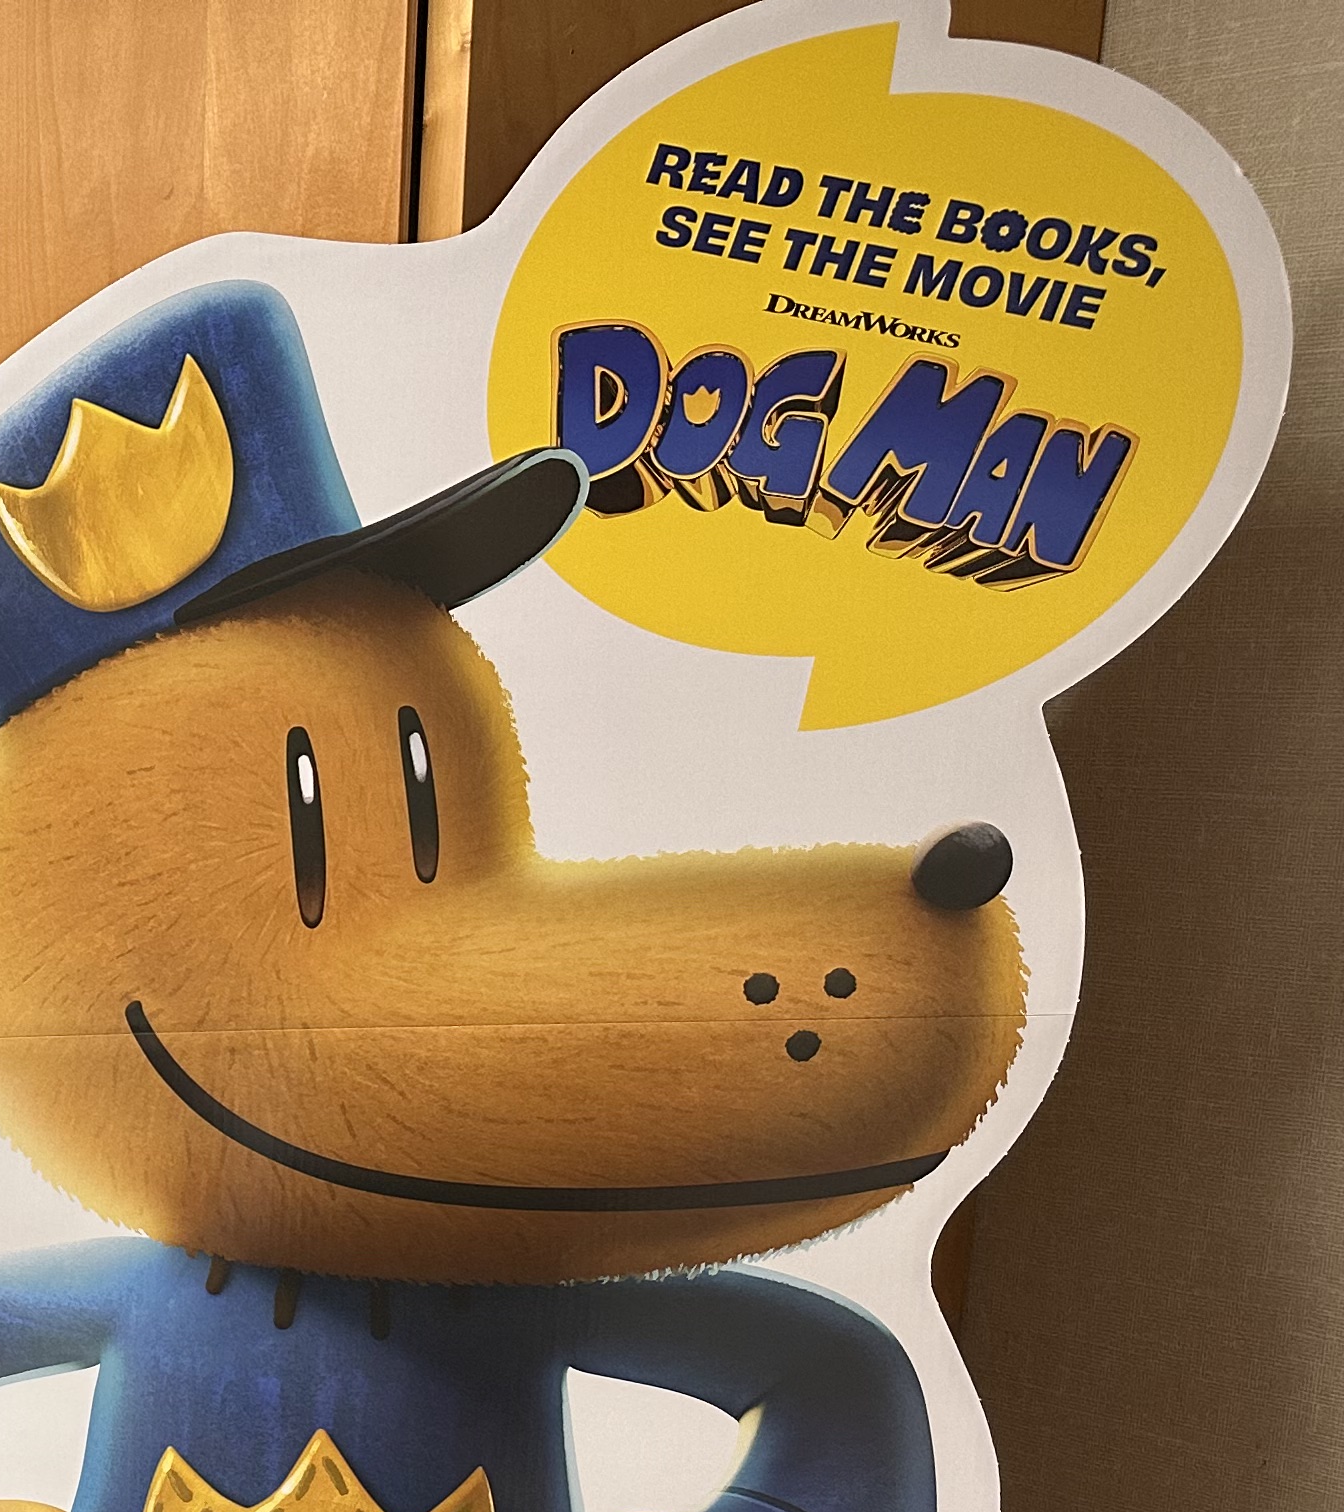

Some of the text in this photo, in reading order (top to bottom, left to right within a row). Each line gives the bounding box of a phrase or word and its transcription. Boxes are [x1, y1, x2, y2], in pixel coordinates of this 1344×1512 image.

[646, 142, 1169, 288] READ THE BOOKS,
[654, 205, 1109, 330] SEE THE MOVIE
[550, 318, 1141, 588] DOG MAN
